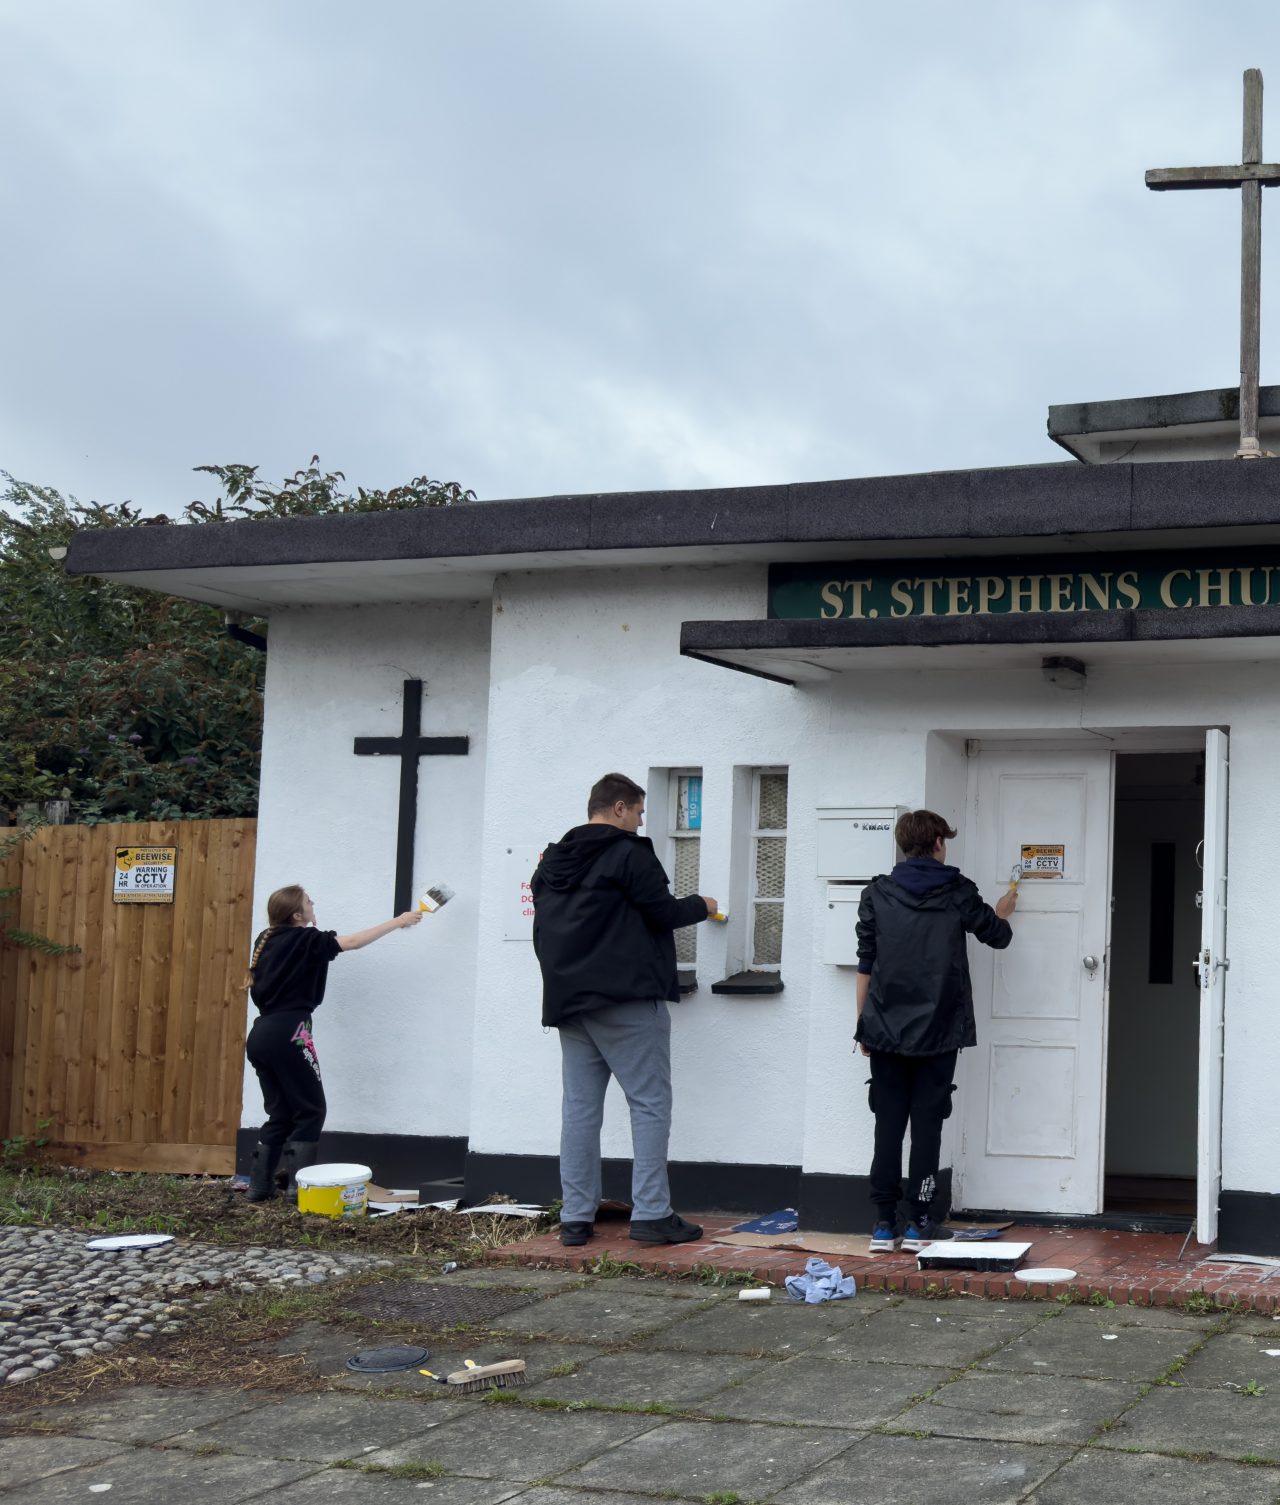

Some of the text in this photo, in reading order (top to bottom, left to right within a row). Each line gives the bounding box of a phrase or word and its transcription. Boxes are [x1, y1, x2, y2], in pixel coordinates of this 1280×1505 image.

[821, 579, 879, 619] ST.
[890, 571, 1142, 617] STEPHENS
[135, 873, 167, 883] CCTV
